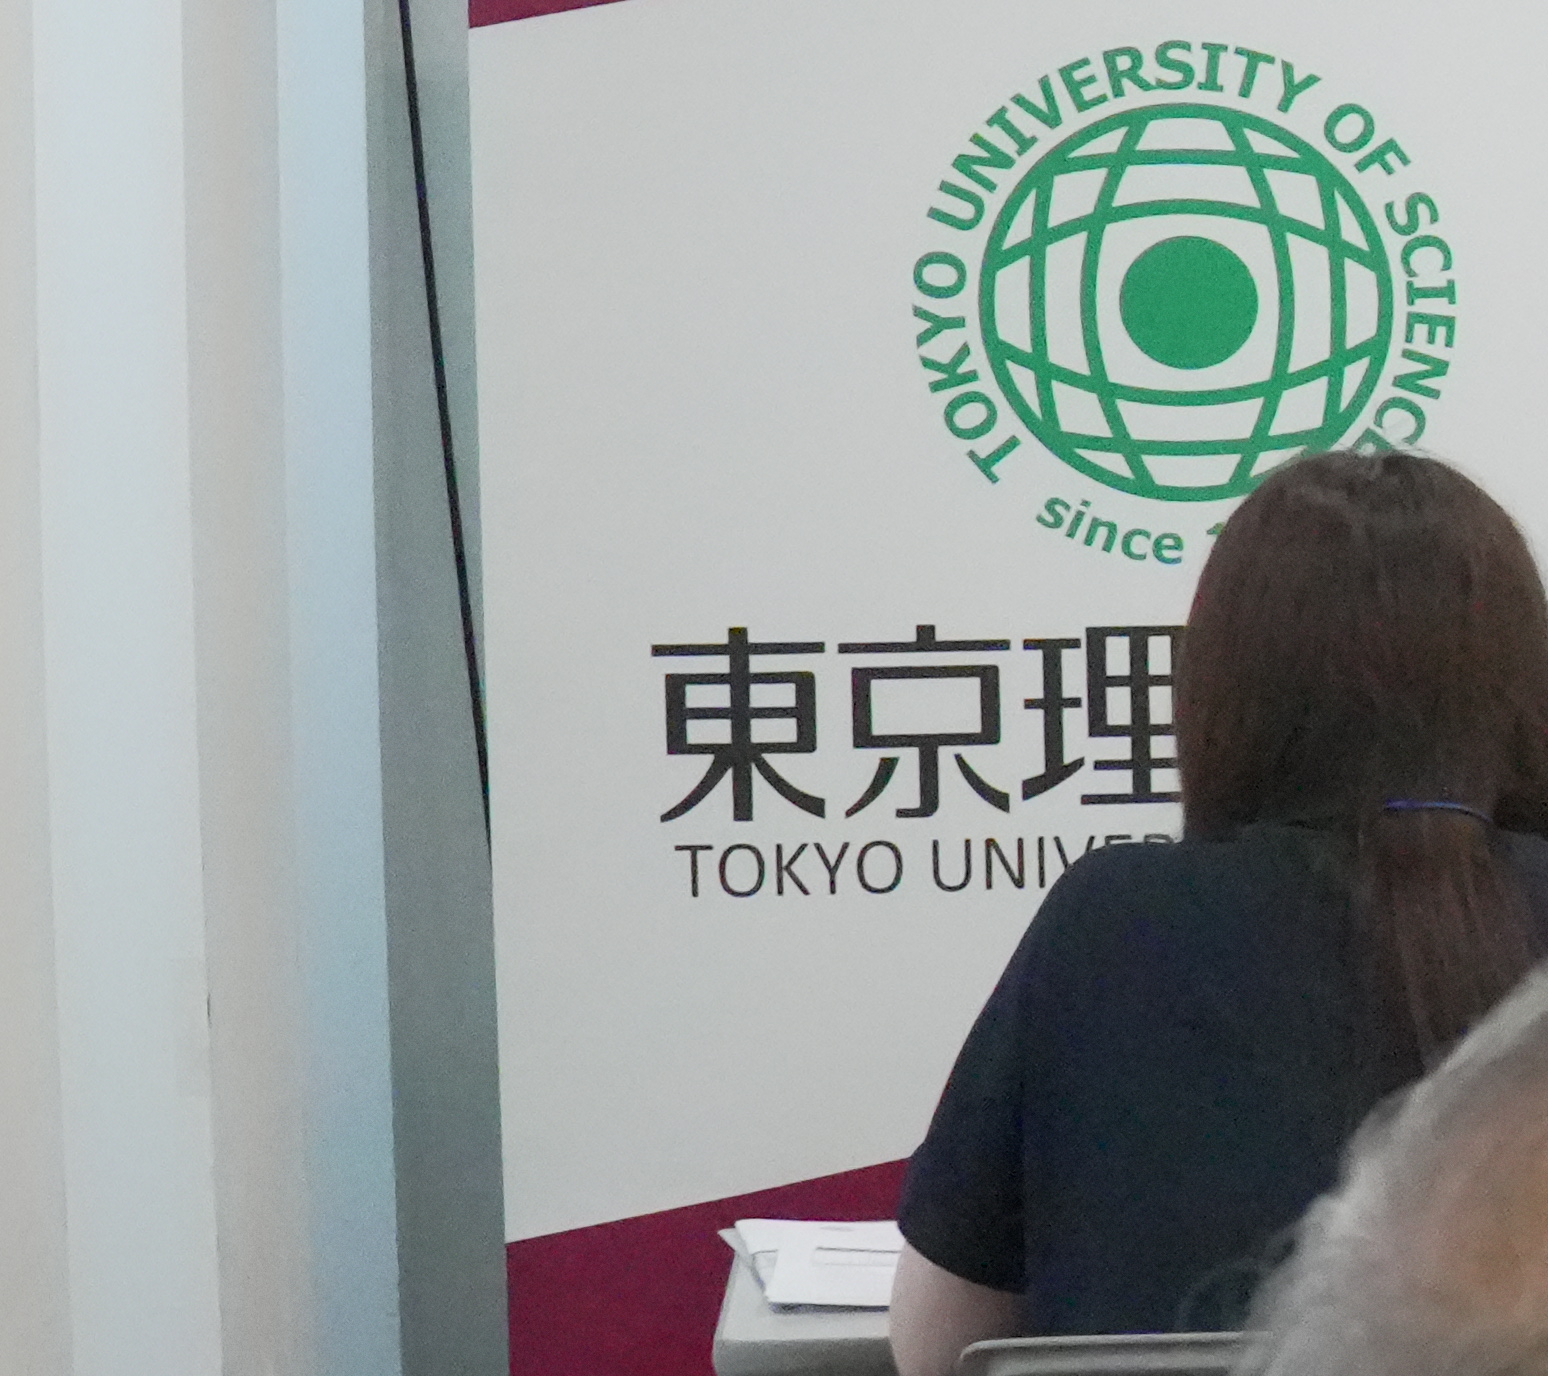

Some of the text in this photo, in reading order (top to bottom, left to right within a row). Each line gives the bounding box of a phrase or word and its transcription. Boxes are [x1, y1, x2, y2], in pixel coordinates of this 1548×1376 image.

[927, 40, 1321, 232] UNIVERSITY
[1323, 102, 1411, 179] OF
[913, 251, 1021, 483] TOKYO
[1035, 495, 1184, 565] since
[674, 839, 903, 898] TOKYO
